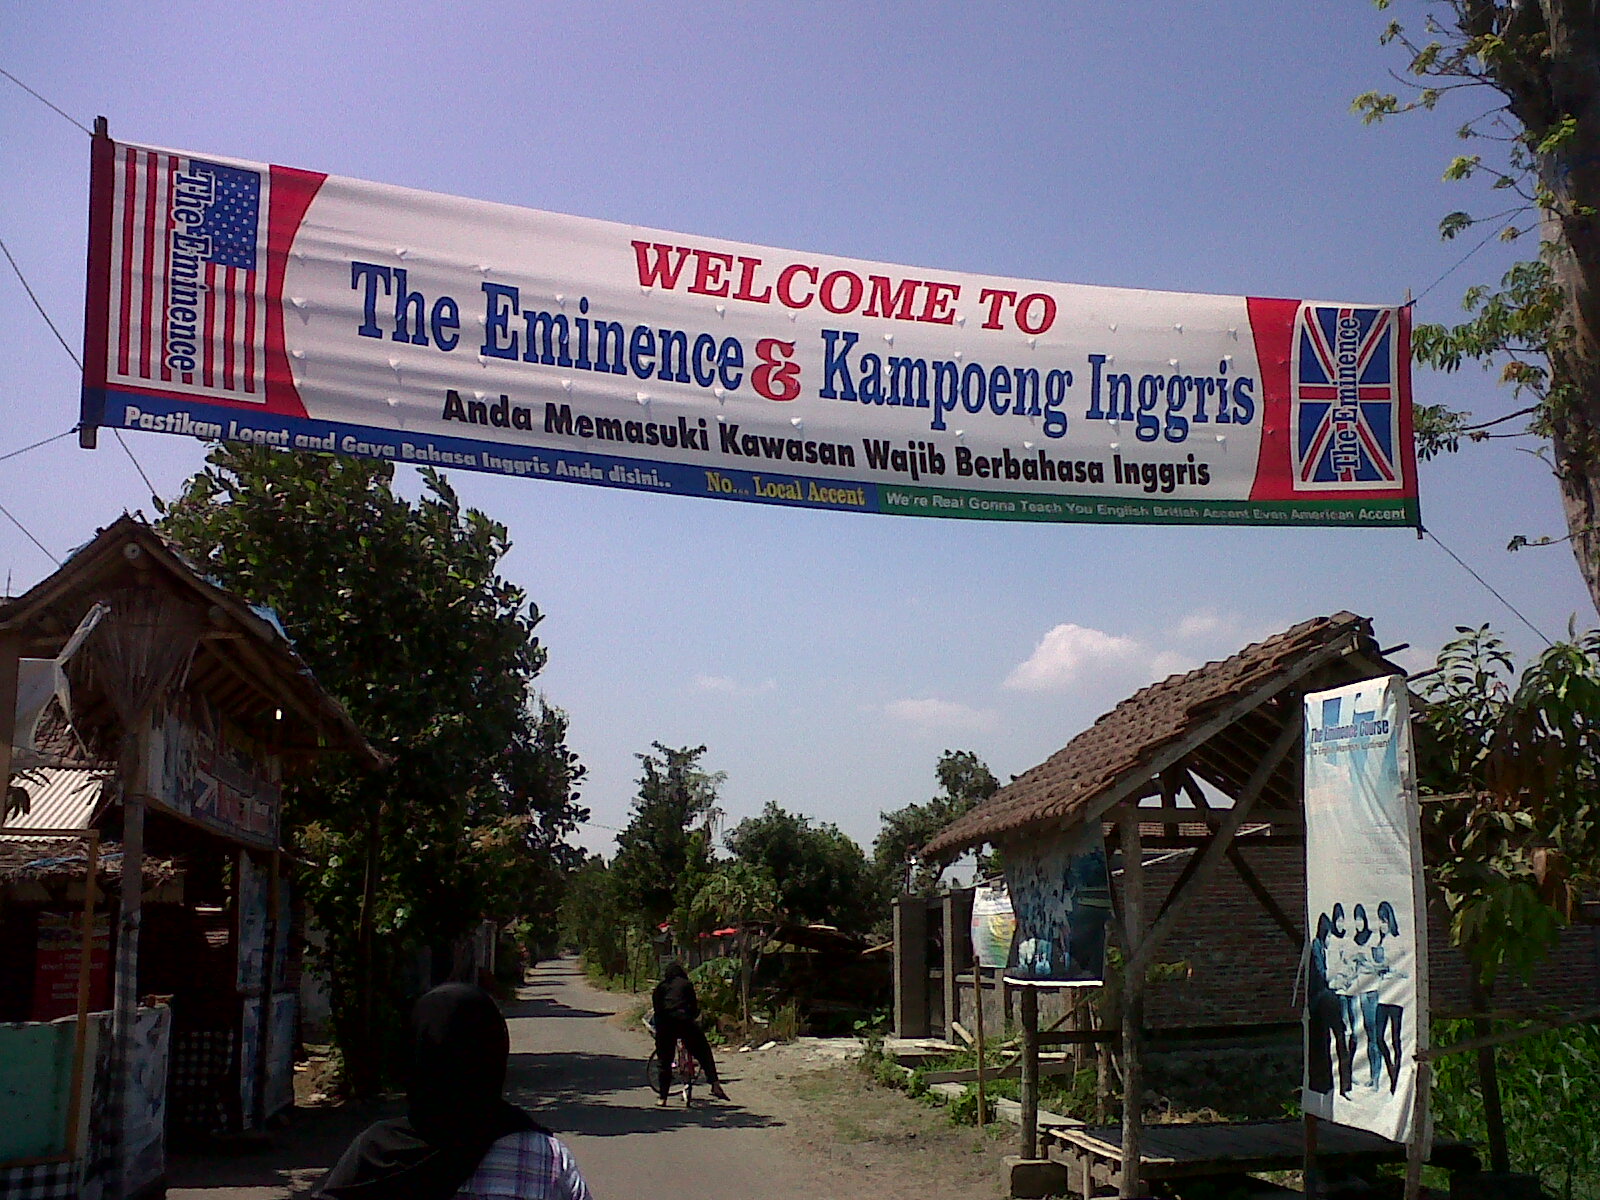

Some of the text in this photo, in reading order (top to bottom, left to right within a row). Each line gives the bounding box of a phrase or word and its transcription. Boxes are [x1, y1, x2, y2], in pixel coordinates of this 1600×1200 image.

[168, 171, 215, 372] The Eminence
[631, 239, 1057, 335] WELCOME TO
[351, 261, 1256, 443] The Eminence & Kampoeng Inggris
[1332, 317, 1358, 471] The Eminence
[124, 405, 222, 438] Pastikan
[228, 420, 290, 446] Logat
[294, 432, 336, 451] and
[341, 436, 396, 459] Gaya
[401, 442, 477, 467] Bahasa
[482, 452, 550, 475] Inggris
[555, 460, 603, 480] Anda
[442, 389, 1211, 493] Anda Memasuki Kawasan Wajib Berbahasa Inggris
[752, 476, 803, 500] Local
[807, 481, 865, 506] Accent
[886, 492, 1406, 521] We're Real Gonna Teach You English British Accent Even American Accent
[1359, 719, 1389, 737] Course
